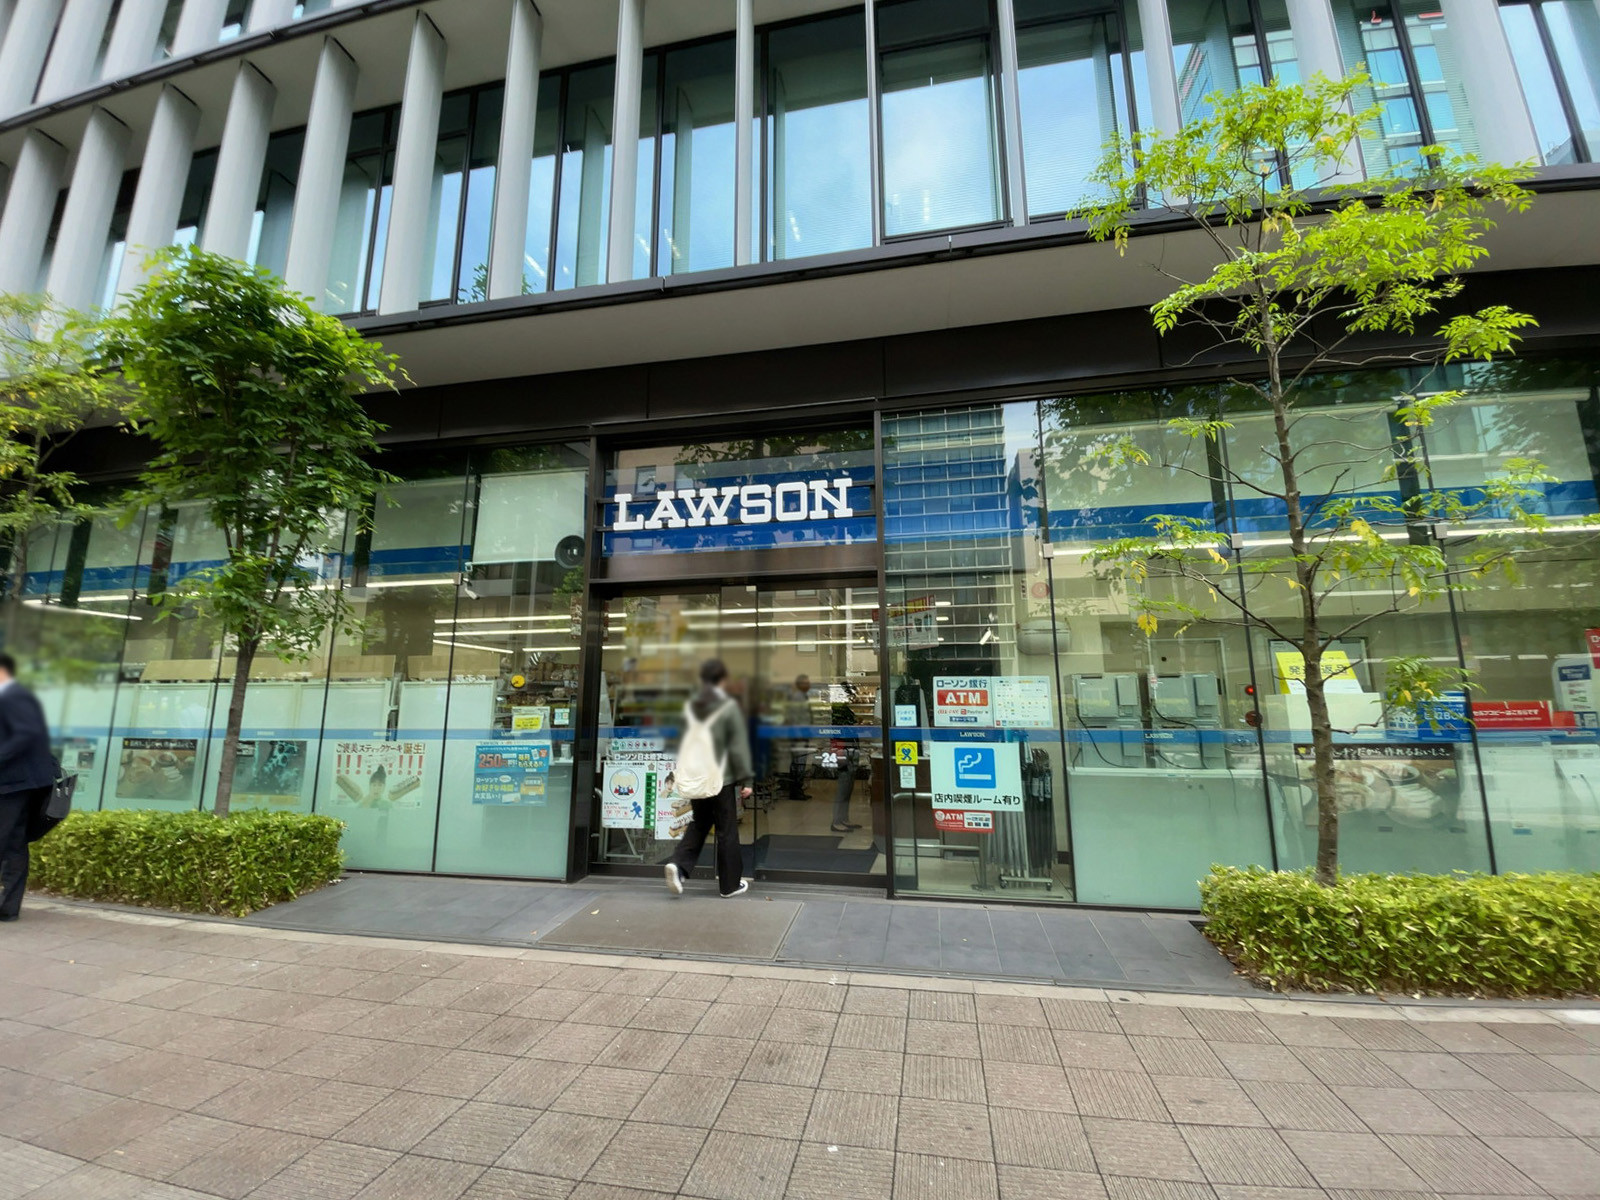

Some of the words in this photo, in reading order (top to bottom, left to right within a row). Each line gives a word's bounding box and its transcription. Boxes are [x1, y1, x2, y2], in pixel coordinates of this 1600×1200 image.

[613, 478, 853, 531] LAWSON
[936, 679, 988, 688] ローソン銀行
[945, 692, 981, 704] ATM
[822, 752, 838, 763] 24
[934, 793, 1020, 806] 店内喫煙ルーム有り
[945, 813, 963, 821] ATM
